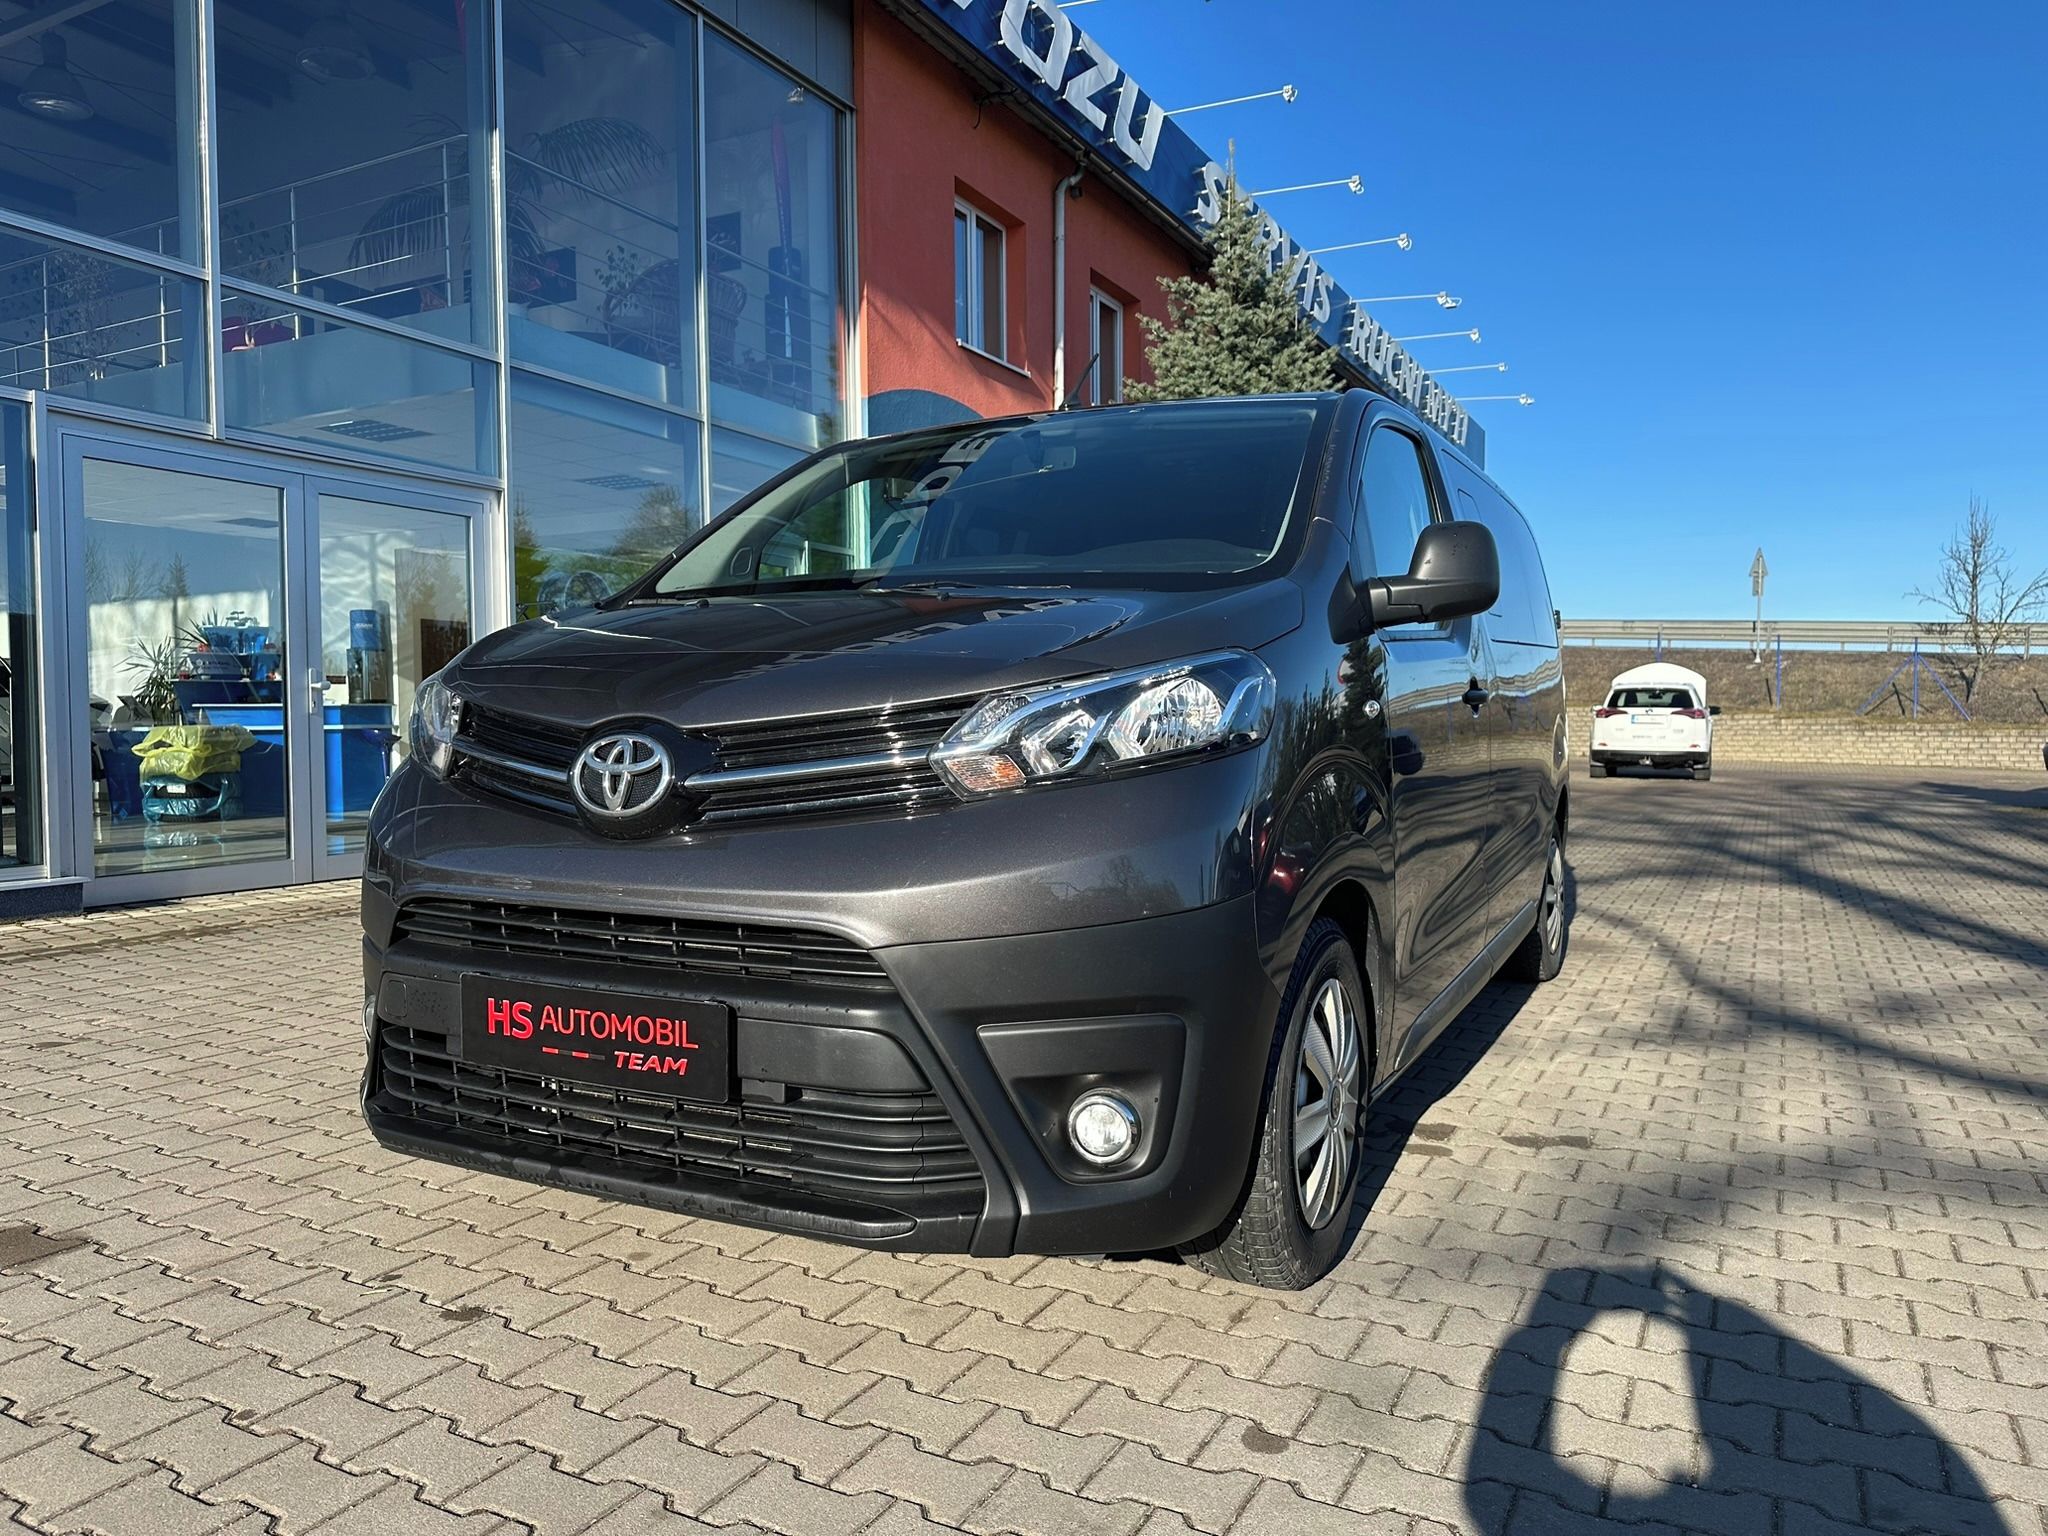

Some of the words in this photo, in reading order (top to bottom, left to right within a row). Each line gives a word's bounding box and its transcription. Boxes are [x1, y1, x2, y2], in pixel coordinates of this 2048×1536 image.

[952, 0, 1164, 171] OZU
[1197, 161, 1335, 324] SRVIS
[487, 997, 534, 1039] HS
[539, 1005, 699, 1049] AUTOMOBIL
[614, 1051, 688, 1075] TEAM
